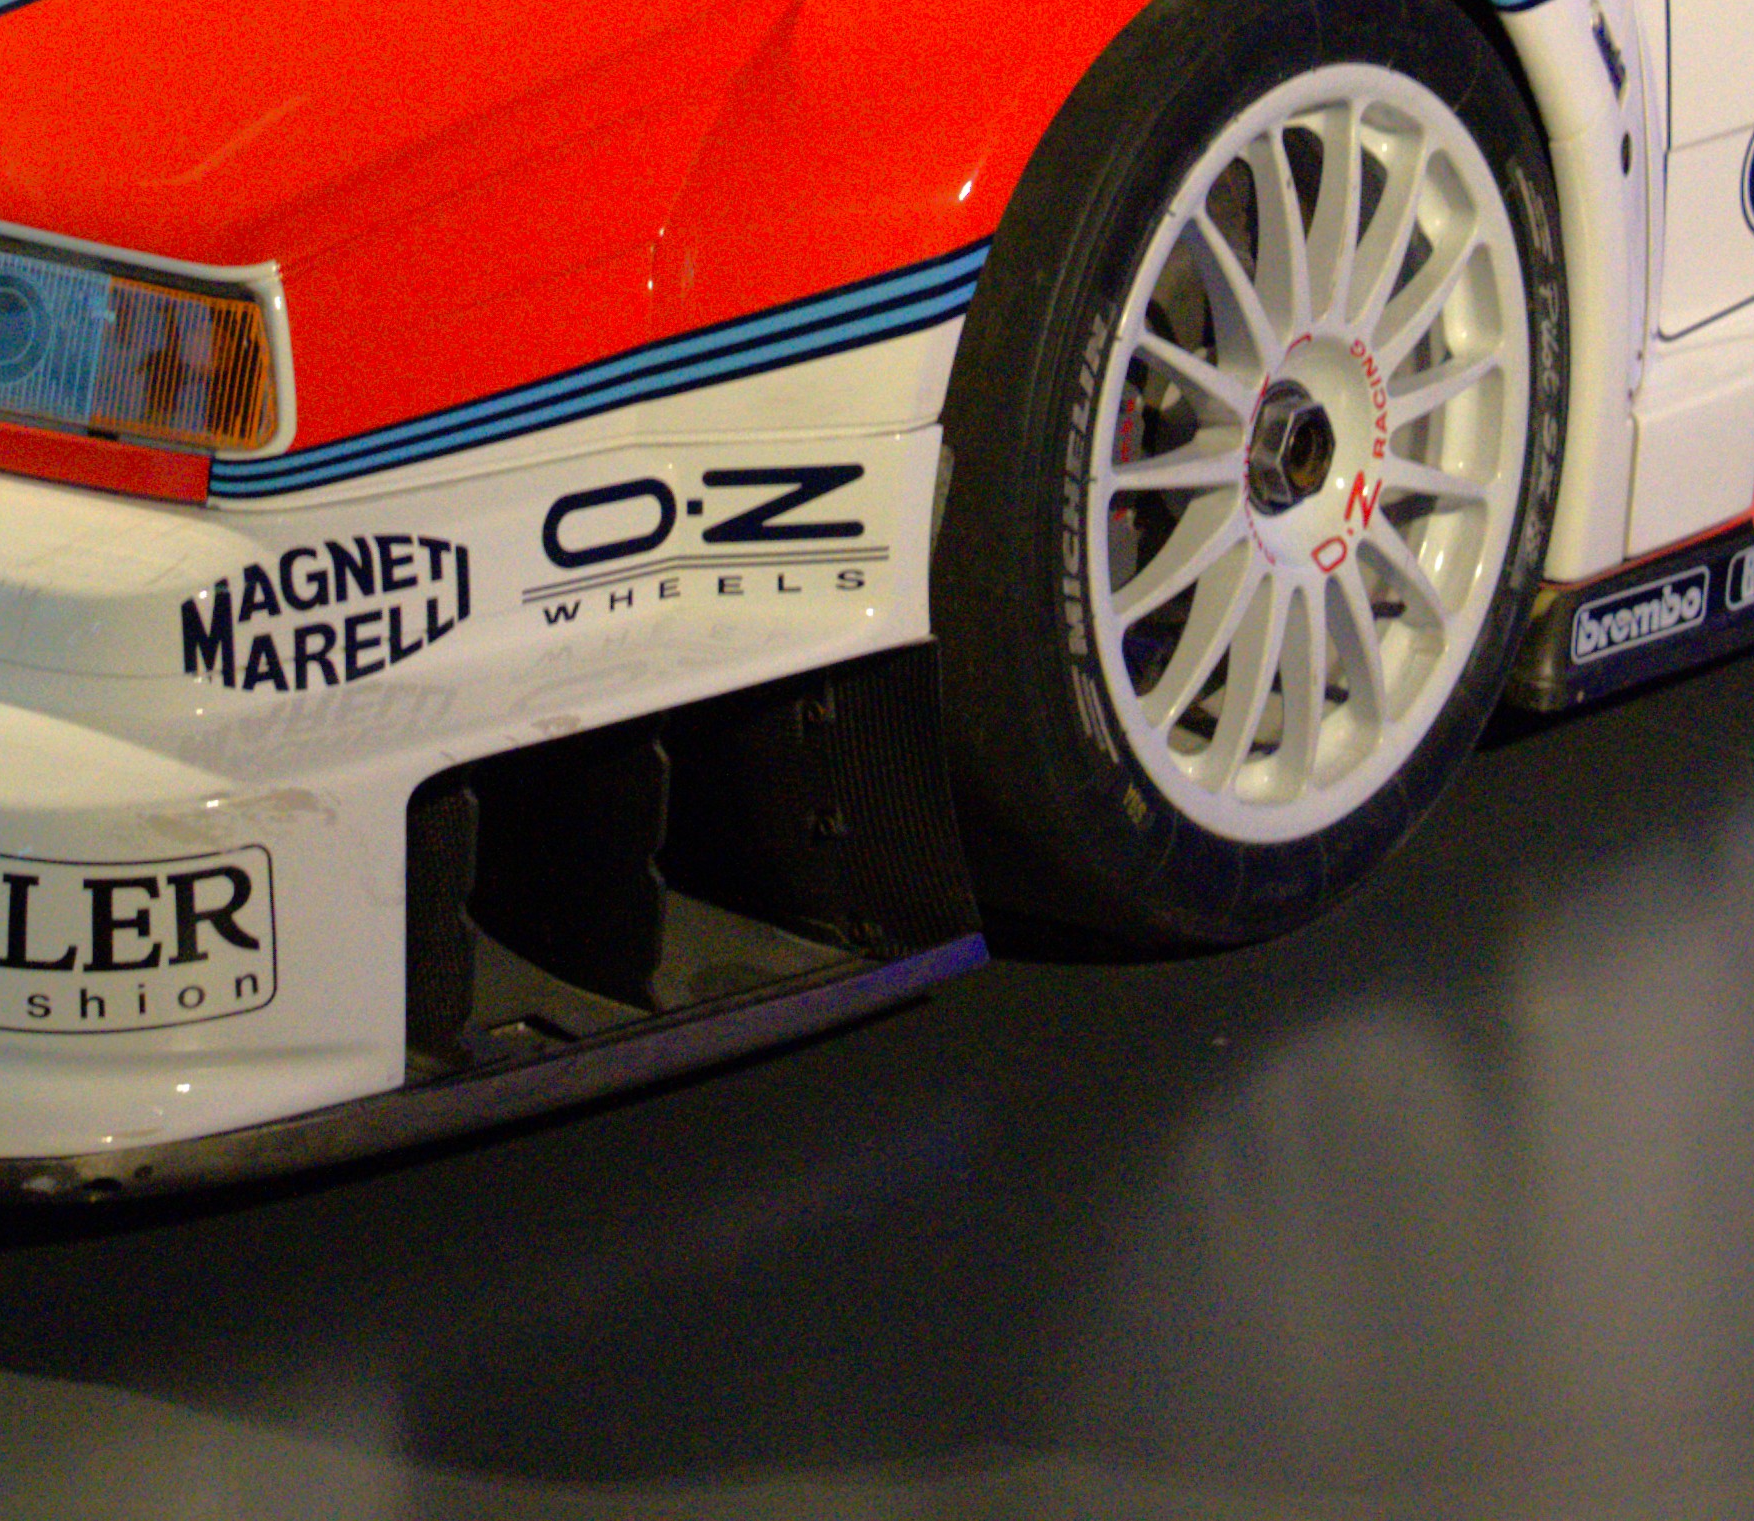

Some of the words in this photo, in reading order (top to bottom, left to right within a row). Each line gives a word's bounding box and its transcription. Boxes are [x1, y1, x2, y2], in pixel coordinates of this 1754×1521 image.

[1349, 338, 1389, 460] RACING
[1062, 312, 1109, 656] MICHELIN
[181, 533, 471, 645] MAGNETI
[181, 580, 471, 693] MARELLI
[543, 569, 867, 627] WHEELS
[1575, 583, 1704, 656] brembo
